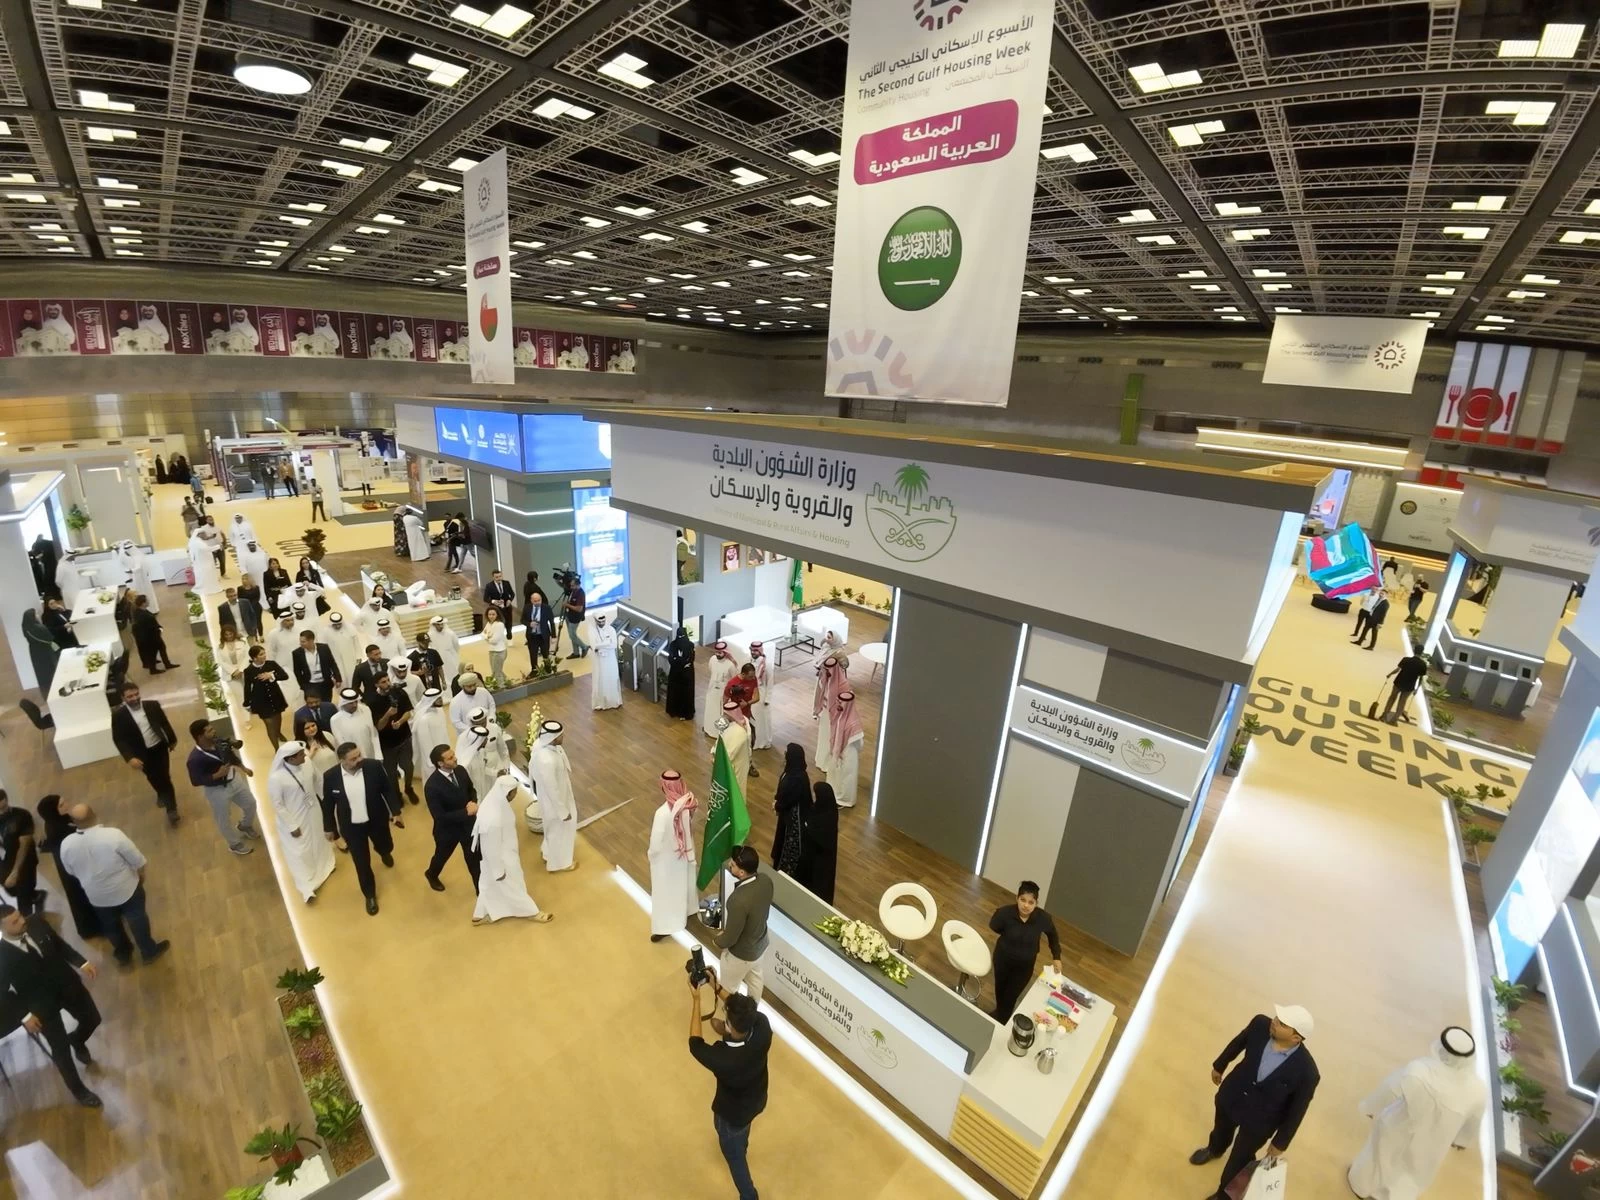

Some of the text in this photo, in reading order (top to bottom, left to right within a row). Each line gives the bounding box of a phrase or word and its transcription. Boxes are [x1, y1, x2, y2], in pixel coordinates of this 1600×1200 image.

[859, 15, 1034, 84] الأسبوع الإسكاني الخليجي الثاني
[857, 40, 1031, 101] The Second Gulf Housing Week
[902, 114, 962, 142] المملكة
[869, 133, 1001, 177] العربية السعودية
[712, 444, 857, 491] وزارة الشؤون البلدية
[710, 475, 853, 527] والقروية والإسكان
[819, 532, 851, 548] Housing
[1027, 712, 1073, 738] والإسكان
[1030, 699, 1119, 740] وزارة الشؤون البلدية
[1073, 729, 1115, 754] والقروية
[1246, 692, 1518, 788] OUSING
[774, 950, 800, 976] البلدية
[774, 963, 814, 1002] والإسكان
[800, 972, 832, 1002] الشؤون
[814, 996, 852, 1033] والقروية
[833, 997, 853, 1021] وزارة
